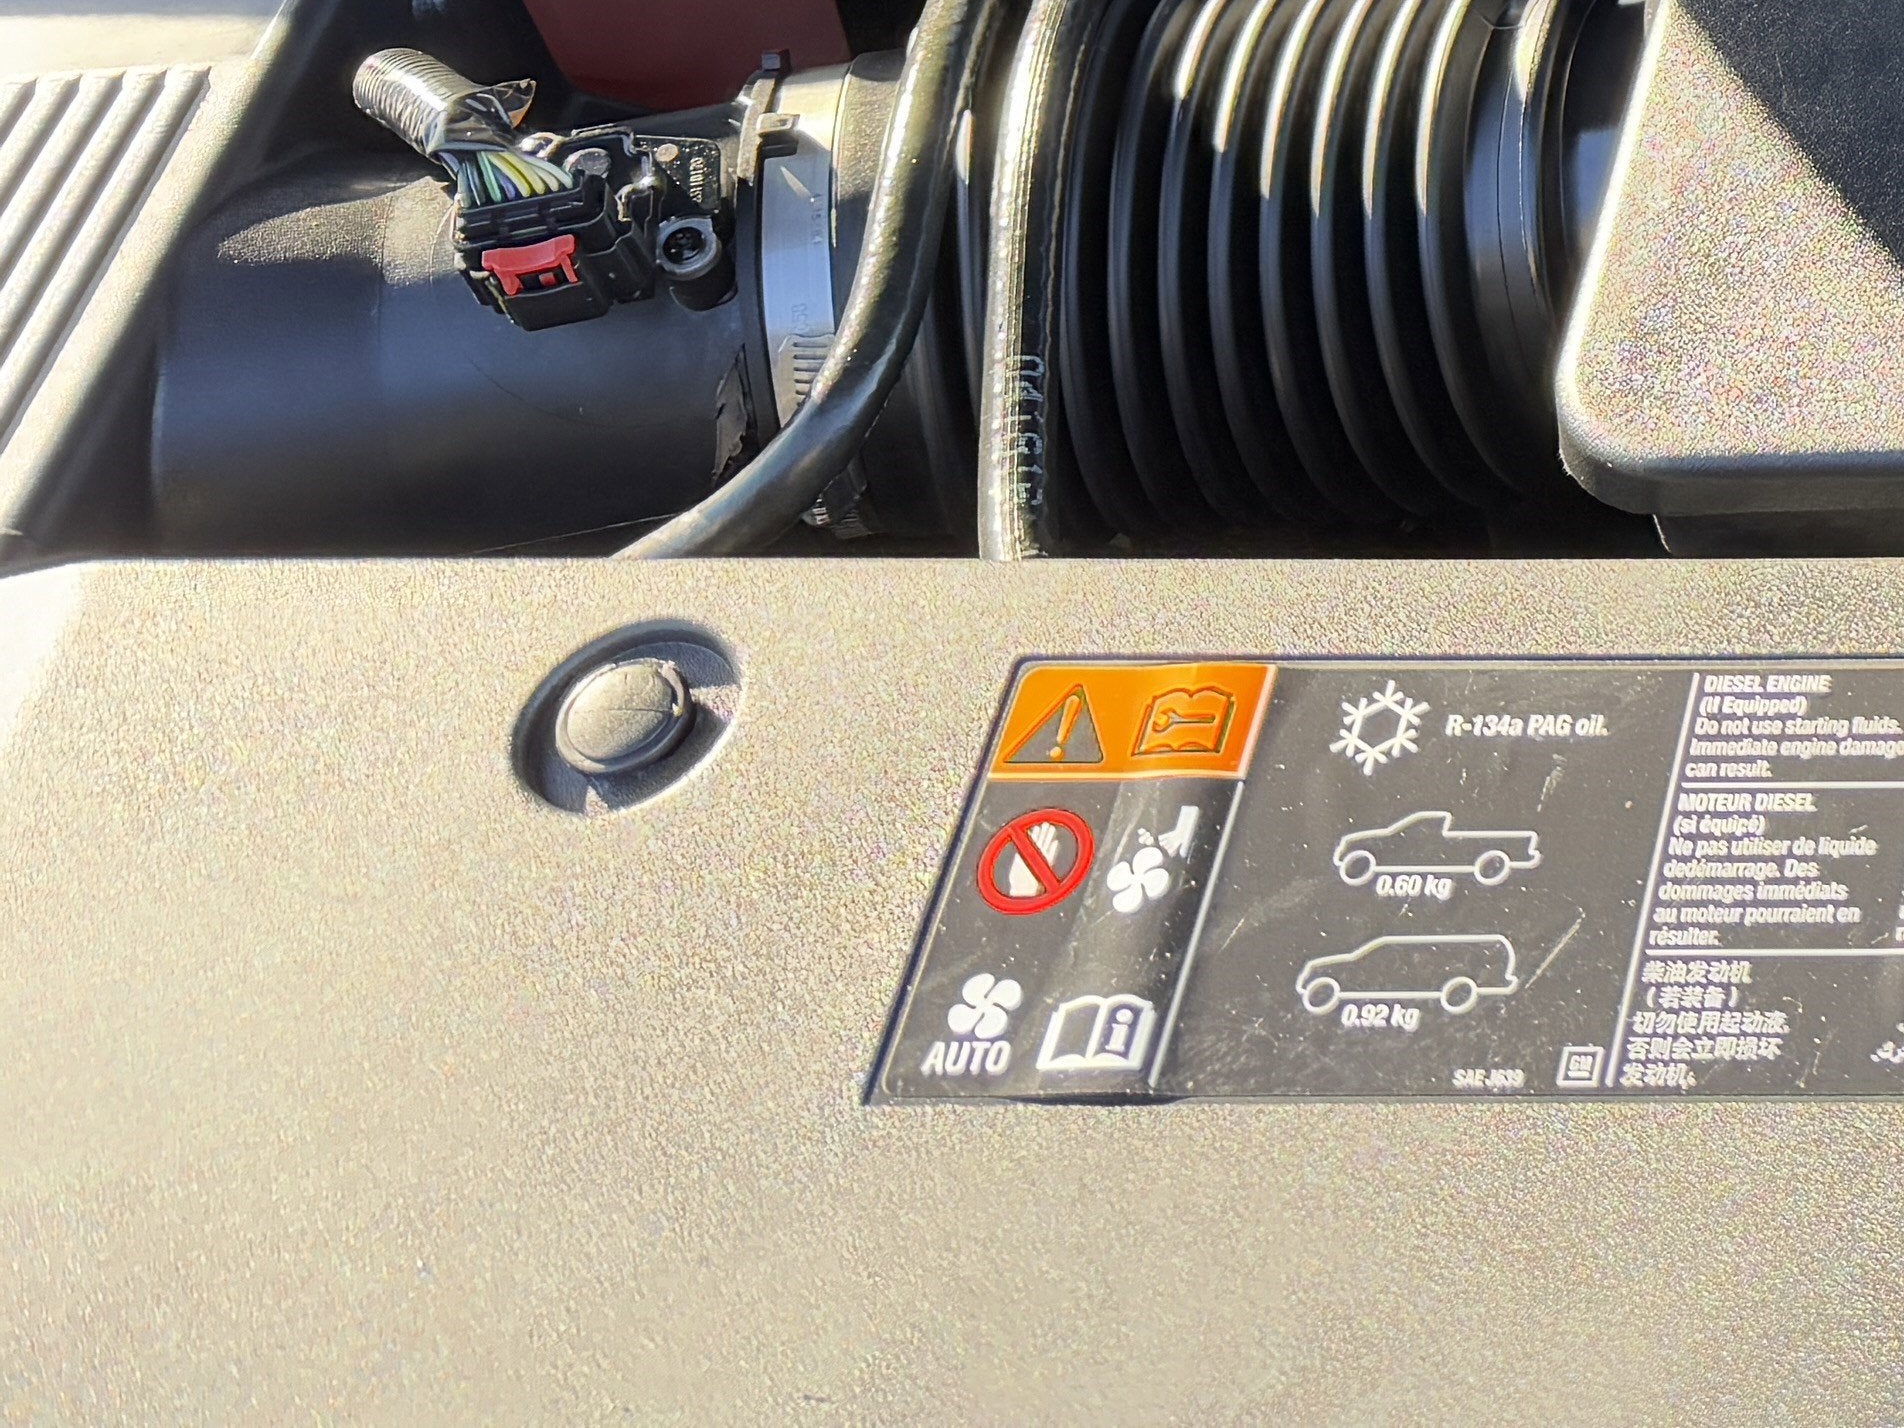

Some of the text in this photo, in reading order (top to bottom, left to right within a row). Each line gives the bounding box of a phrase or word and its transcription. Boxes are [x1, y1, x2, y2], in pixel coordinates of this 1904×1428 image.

[1704, 674, 1833, 693] DIESEL ENGINE
[1722, 696, 1807, 716] Equipped)
[1445, 714, 1610, 737] R-134a PAG oil.
[1695, 716, 1904, 737] Do not use starting fluids.
[1690, 738, 1778, 756] Immediate
[1780, 740, 1837, 759] engine
[1685, 760, 1773, 777] can result.
[1677, 793, 1818, 812] MOTEUR DIESEL
[1673, 814, 1766, 834] (si équipé)
[1668, 836, 1878, 858] Ne pas utiliser de liquide
[1784, 859, 1821, 878] Des
[1376, 874, 1452, 901] 0.60 kg
[1658, 881, 1849, 903] dommages immédiats
[1653, 904, 1861, 927] au moteur pourraient en
[1649, 926, 1723, 947] résulter.
[1642, 960, 1753, 984] 柴油发动机
[1341, 1004, 1420, 1032] 0.92 kg
[920, 1040, 1012, 1076] AUTO
[1626, 1036, 1784, 1061] 否则会立即损坏
[1452, 1069, 1485, 1088] SAE
